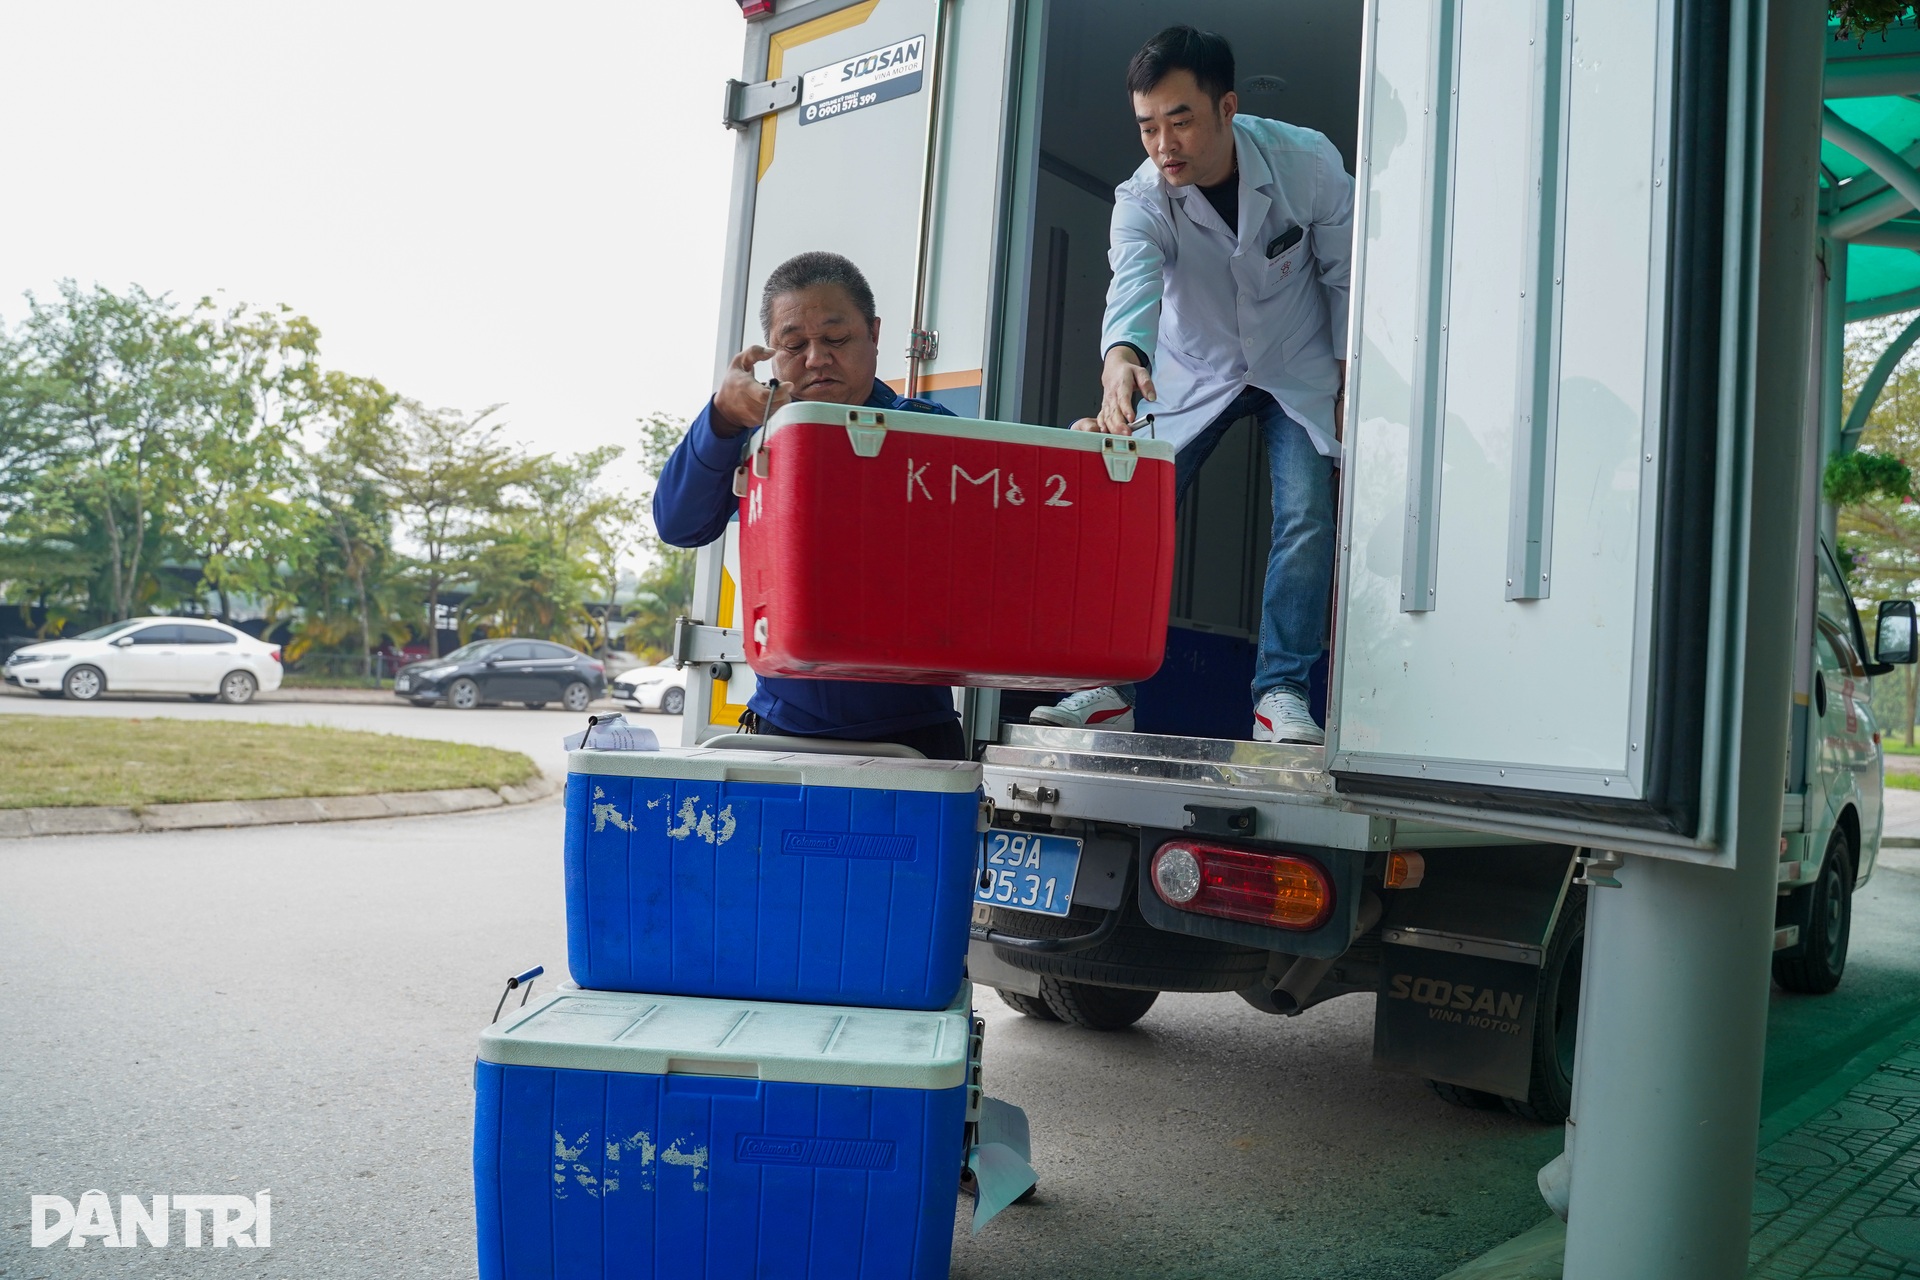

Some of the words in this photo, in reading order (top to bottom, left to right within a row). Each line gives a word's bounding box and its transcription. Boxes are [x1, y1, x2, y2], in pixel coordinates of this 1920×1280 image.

[841, 41, 921, 82] SOOSAN
[874, 70, 891, 81] VINA
[892, 62, 919, 76] MOTOR
[818, 103, 841, 118] 0901
[842, 97, 859, 111] 575
[859, 92, 877, 106] 399
[790, 836, 827, 848] Coleman
[990, 834, 1041, 869] 29A
[1389, 974, 1523, 1019] SOOSAN
[1429, 1007, 1462, 1024] VINA
[1467, 1015, 1521, 1035] MOTOR
[746, 1140, 789, 1155] Coleman
